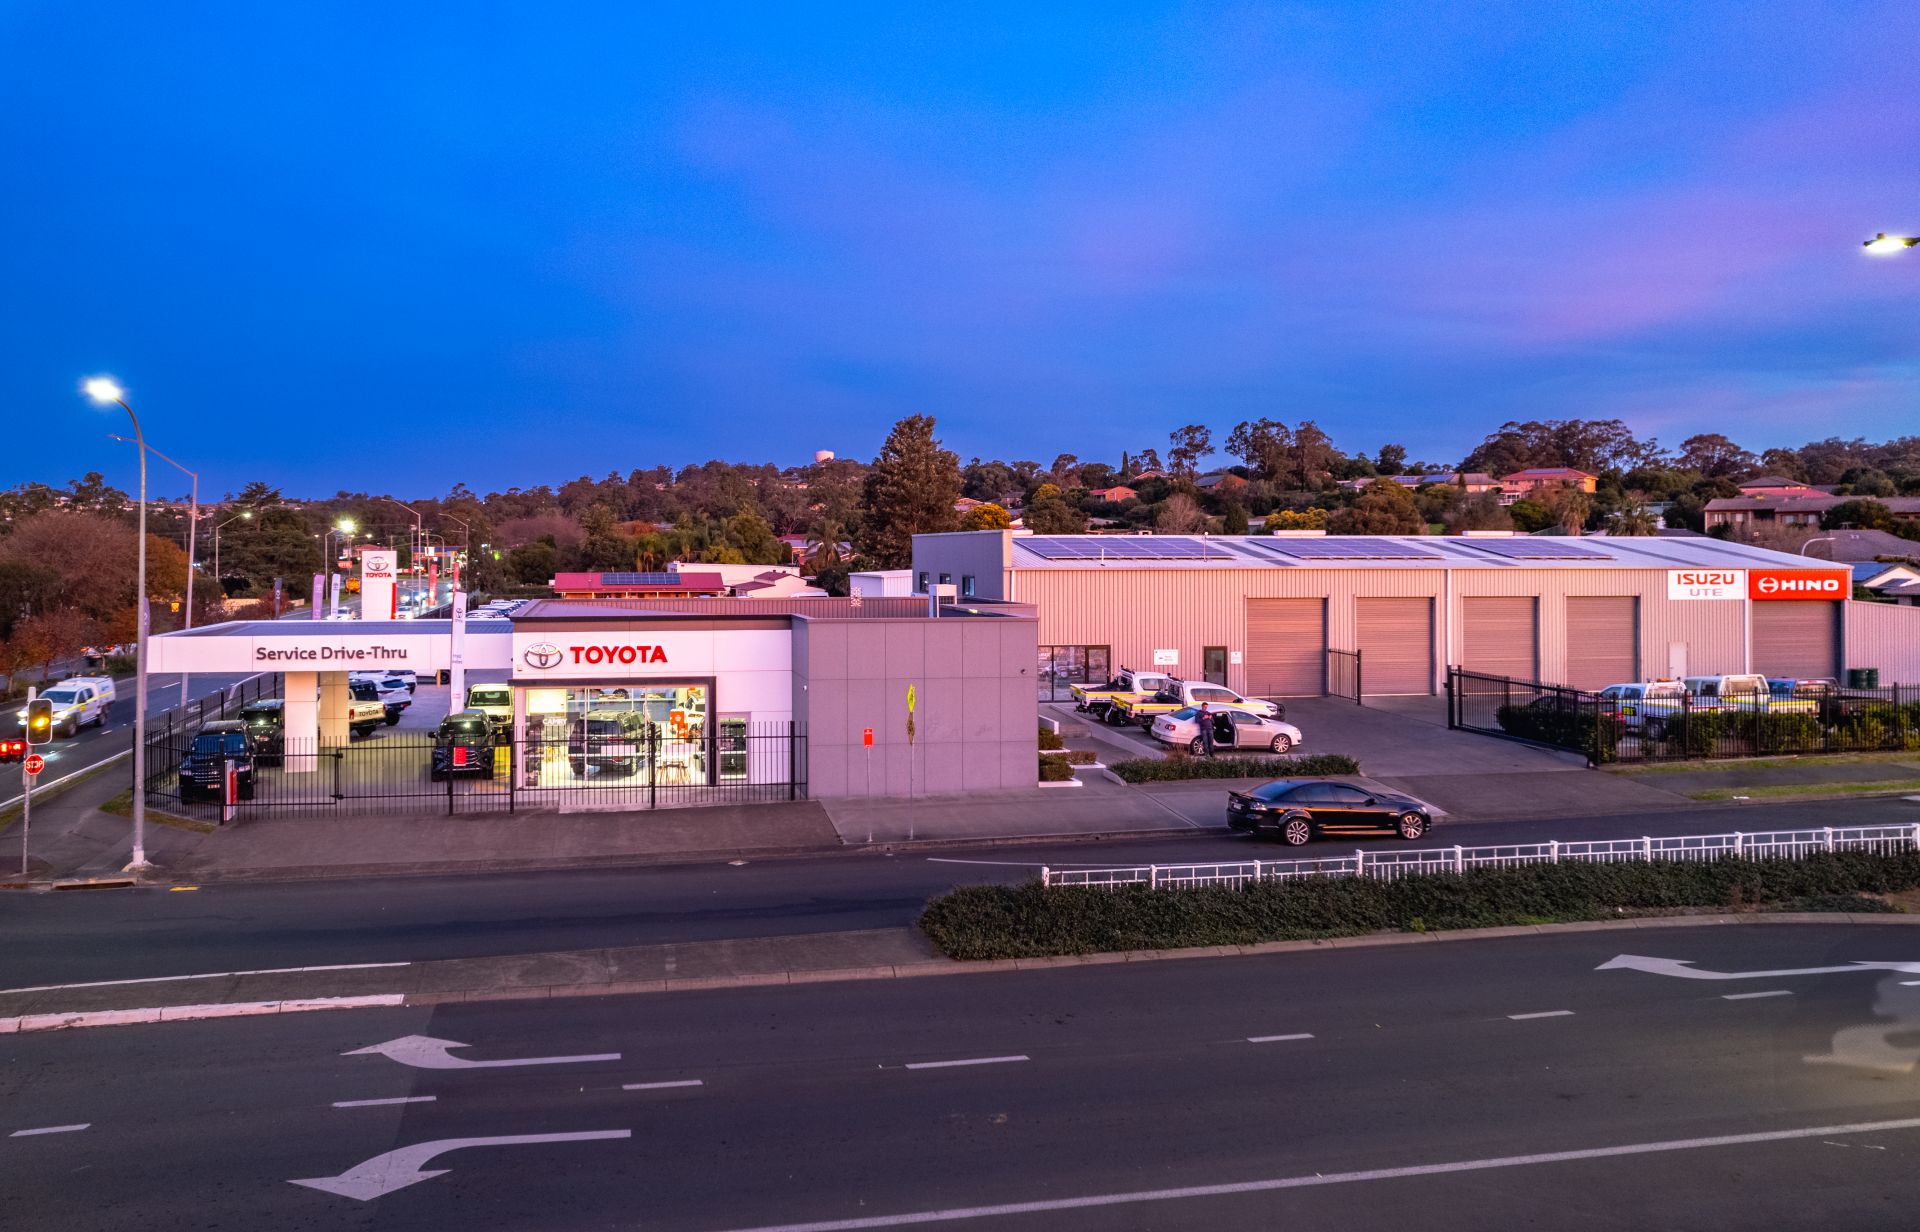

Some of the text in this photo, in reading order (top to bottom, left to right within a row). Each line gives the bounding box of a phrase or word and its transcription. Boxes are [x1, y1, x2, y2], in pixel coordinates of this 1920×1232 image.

[1676, 573, 1735, 586] ISUZU
[1781, 579, 1839, 591] HINO
[1689, 588, 1723, 597] UTE
[256, 646, 408, 660] Service Drive-Thru
[570, 645, 668, 664] TOYOTA
[26, 760, 43, 769] STOP
